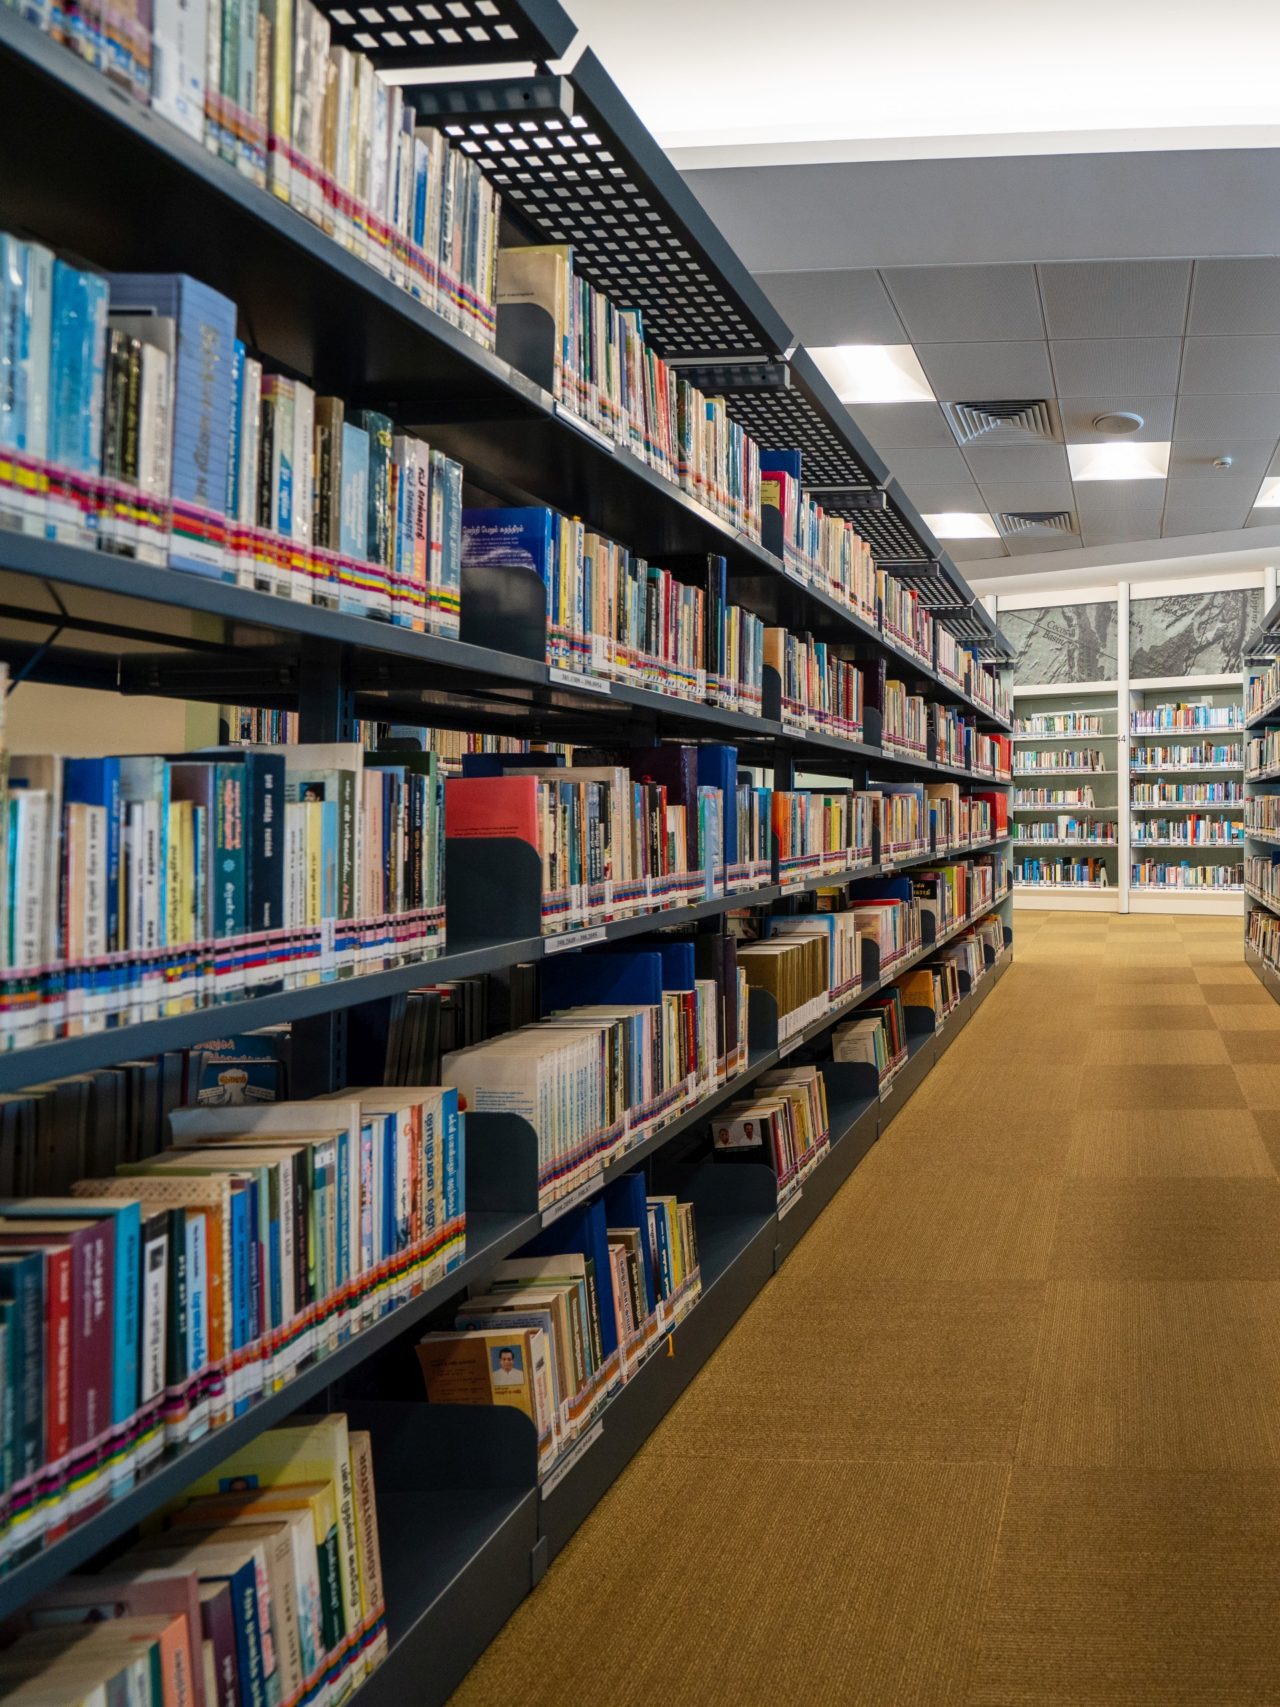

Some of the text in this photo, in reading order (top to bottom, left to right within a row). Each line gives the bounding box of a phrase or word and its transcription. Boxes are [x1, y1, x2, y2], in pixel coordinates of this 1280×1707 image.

[1046, 620, 1070, 637] Cocos
[1042, 629, 1065, 647] Basin
[359, 1451, 377, 1581] ADMINISTRATOR
